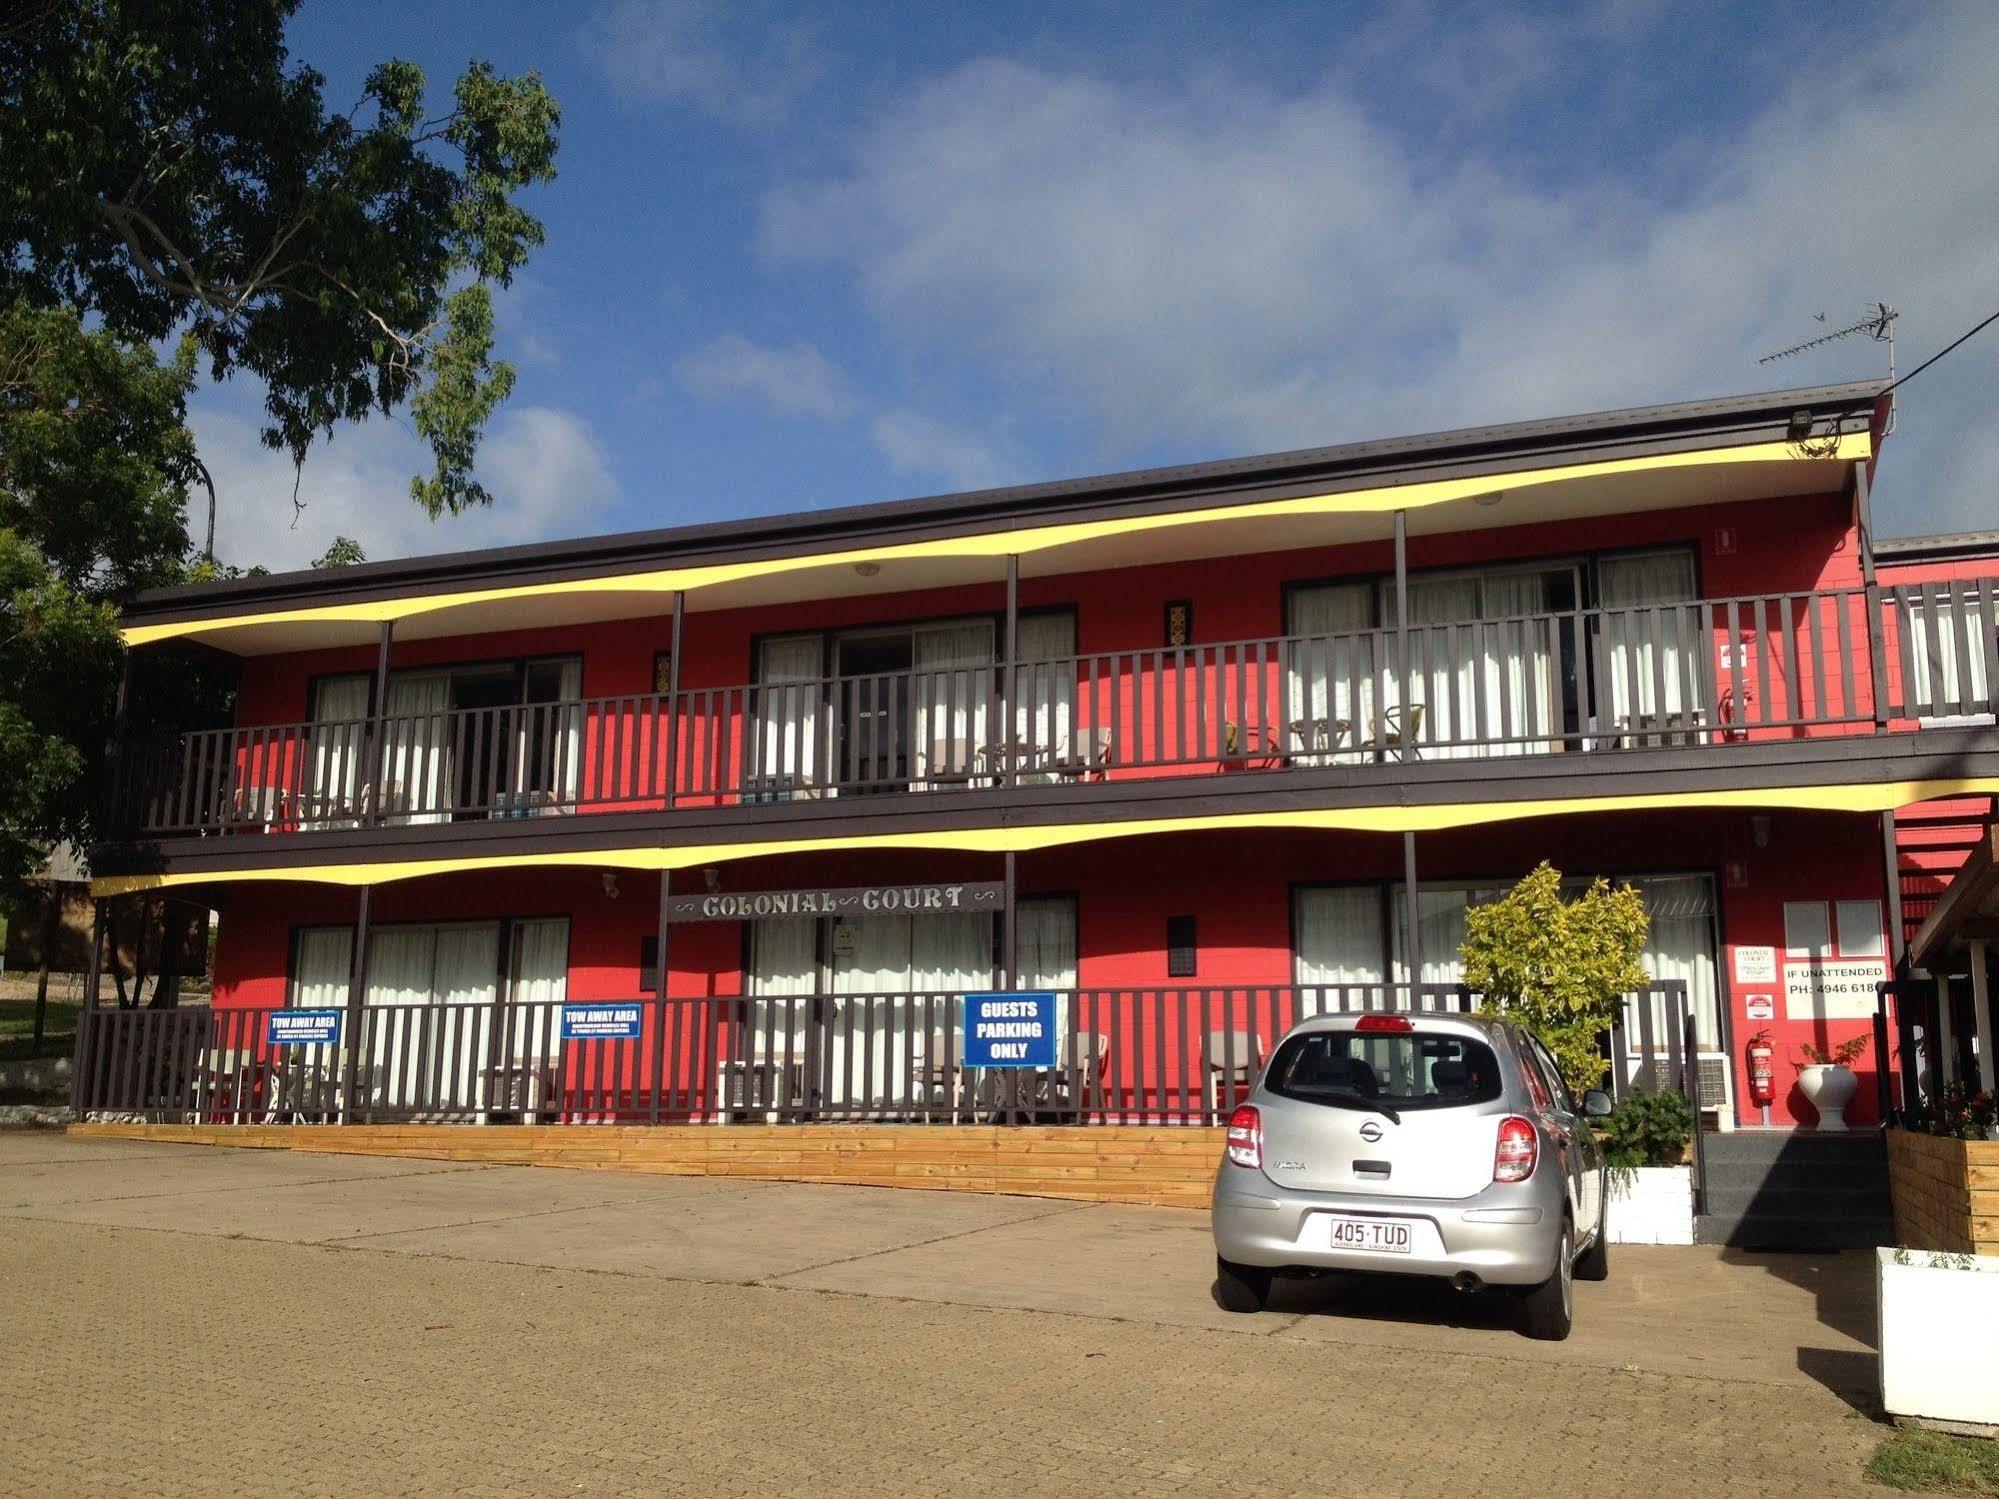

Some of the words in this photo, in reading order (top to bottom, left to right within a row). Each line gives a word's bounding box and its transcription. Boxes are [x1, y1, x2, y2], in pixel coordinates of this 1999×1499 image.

[702, 891, 838, 917] COLONIAL
[862, 886, 963, 909] COURT
[1787, 970, 1797, 979] IF
[1801, 968, 1883, 978] UNATTENDED
[1789, 985, 1813, 994] PH:
[1817, 984, 1847, 993] 4946
[1851, 983, 1878, 993] 618
[565, 1011, 586, 1023] TOW
[587, 1010, 614, 1022] AWAY
[614, 1010, 638, 1021] AREA
[980, 1001, 1038, 1018] GUESTS
[271, 1017, 291, 1028] TOW
[290, 1017, 315, 1028] AWAY
[315, 1016, 336, 1027] AREA
[976, 1022, 1042, 1038] PARKING
[990, 1043, 1028, 1059] ONLY
